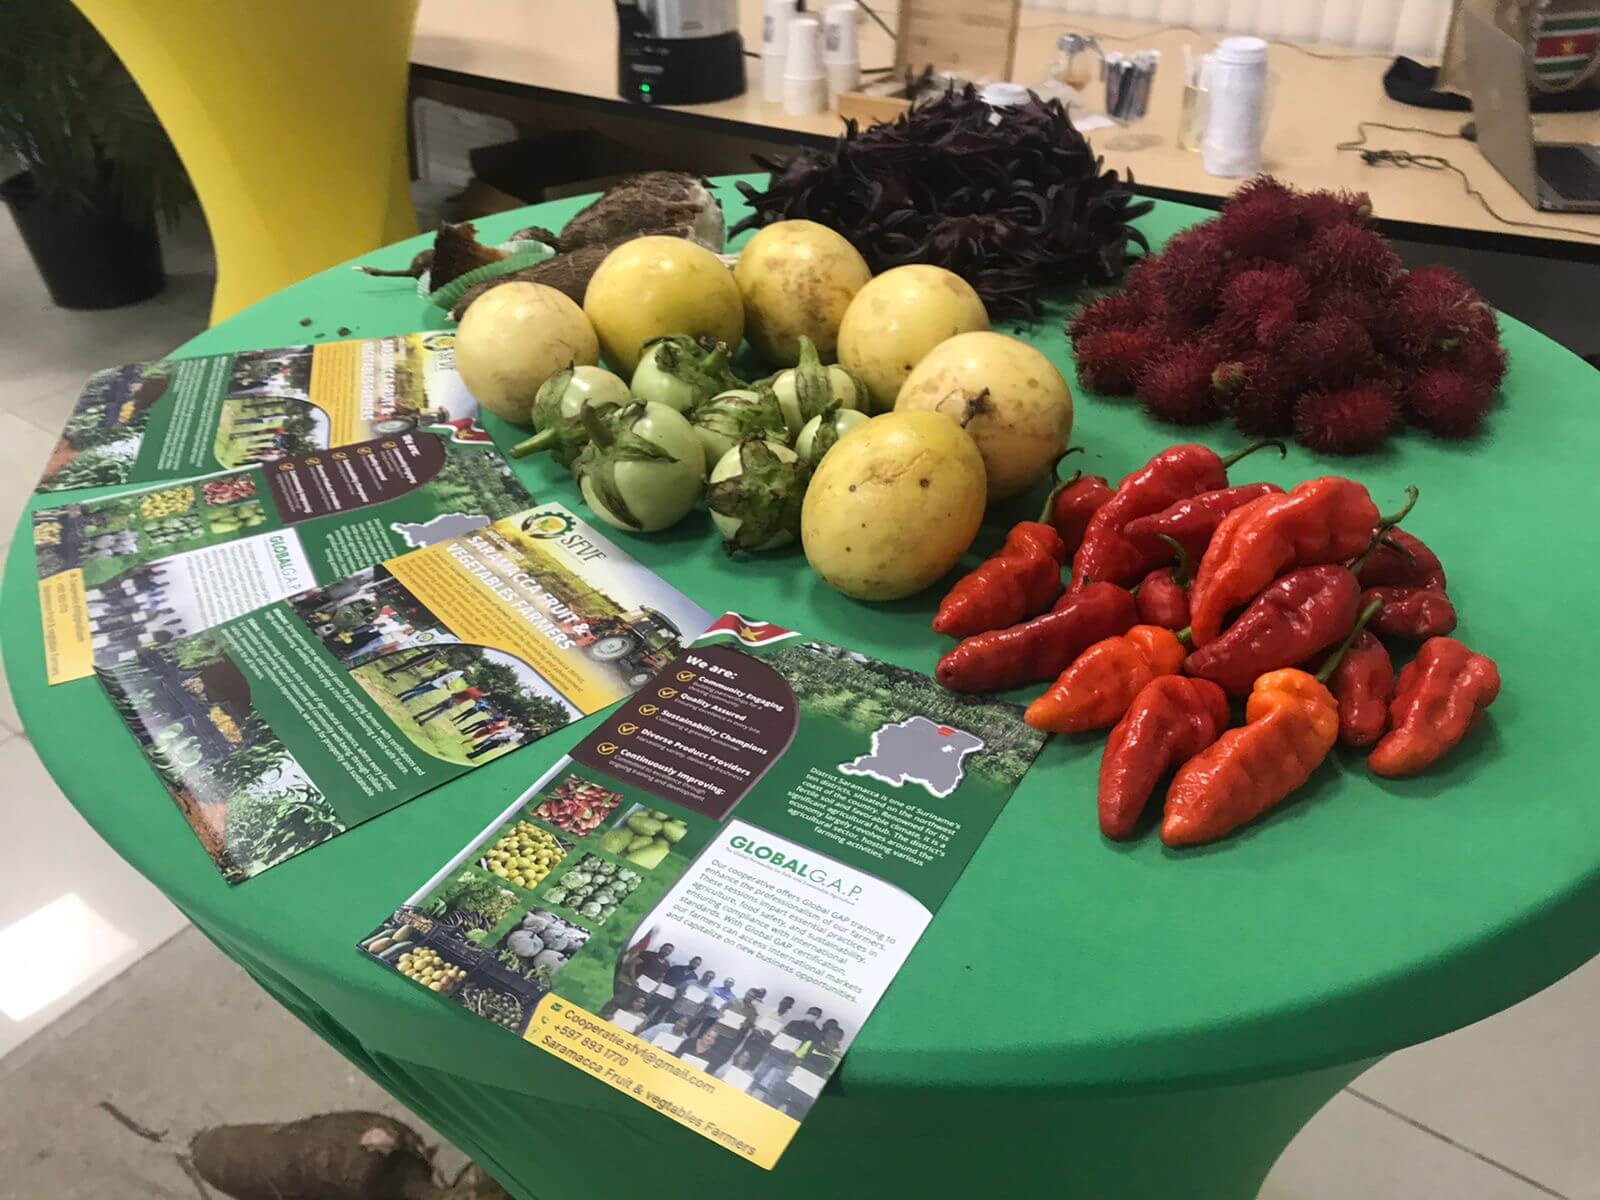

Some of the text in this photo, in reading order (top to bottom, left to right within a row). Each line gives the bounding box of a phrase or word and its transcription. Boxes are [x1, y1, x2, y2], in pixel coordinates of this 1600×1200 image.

[560, 534, 608, 561] SFVF
[446, 543, 519, 601] VEGETABLES
[511, 596, 576, 650] FARMERS
[466, 535, 542, 593] SARAMACCA
[539, 591, 580, 623] FRUIT
[572, 622, 589, 636] &
[685, 654, 738, 680] We are:
[697, 675, 784, 712] Community Engaging
[660, 709, 768, 755] Sustainability Champions
[679, 692, 747, 721] Quality Assured
[619, 748, 726, 795] Continuously Improving:
[640, 727, 751, 776] Diverse Product Providers
[786, 790, 827, 810] significant
[826, 806, 873, 828] agricultural
[893, 831, 909, 842] The
[909, 839, 945, 857] district's
[795, 784, 820, 798] fertile
[819, 795, 836, 804] soil
[834, 801, 852, 811] and
[850, 806, 890, 826] favorable
[922, 835, 931, 843] it
[930, 838, 939, 846] is
[801, 780, 823, 792] coast
[832, 791, 847, 801] the
[880, 810, 925, 832] Renowned
[924, 827, 938, 837] for
[937, 832, 949, 842] its
[805, 773, 819, 783] ten
[852, 792, 887, 808] situated
[885, 805, 898, 813] on
[898, 809, 913, 819] the
[912, 815, 956, 836] northwest
[809, 766, 838, 782] District
[837, 777, 880, 798] Saramacca
[888, 797, 905, 807] one
[904, 804, 916, 812] of
[914, 807, 961, 829] Suriname's
[786, 807, 833, 829] agricultural
[860, 835, 893, 855] hosting
[892, 849, 924, 866] various
[788, 799, 934, 861] economy largely revolves around the
[813, 825, 846, 844] farming
[685, 888, 848, 964] ensuring compliance with international
[698, 872, 878, 958] These sessions impart essential practices in
[704, 866, 740, 885] enhance
[739, 881, 755, 891] the
[752, 888, 821, 921] professionalism
[821, 918, 834, 926] of
[832, 922, 849, 933] our
[710, 858, 897, 945] Our cooperative offers Global GAP training to
[738, 900, 760, 914] food
[788, 924, 808, 936] and
[665, 911, 684, 922] and
[682, 918, 723, 940] capitalize
[722, 936, 736, 946] on
[735, 942, 755, 955] new
[754, 951, 794, 974] business
[671, 903, 863, 994] our farmers can access international markets
[723, 914, 743, 928] With
[743, 923, 774, 941] Global
[772, 937, 793, 949] GAP
[553, 1024, 629, 1066] +597 893 1770
[540, 1034, 757, 1156] Saramacca Fruit & vegtables Farmers
